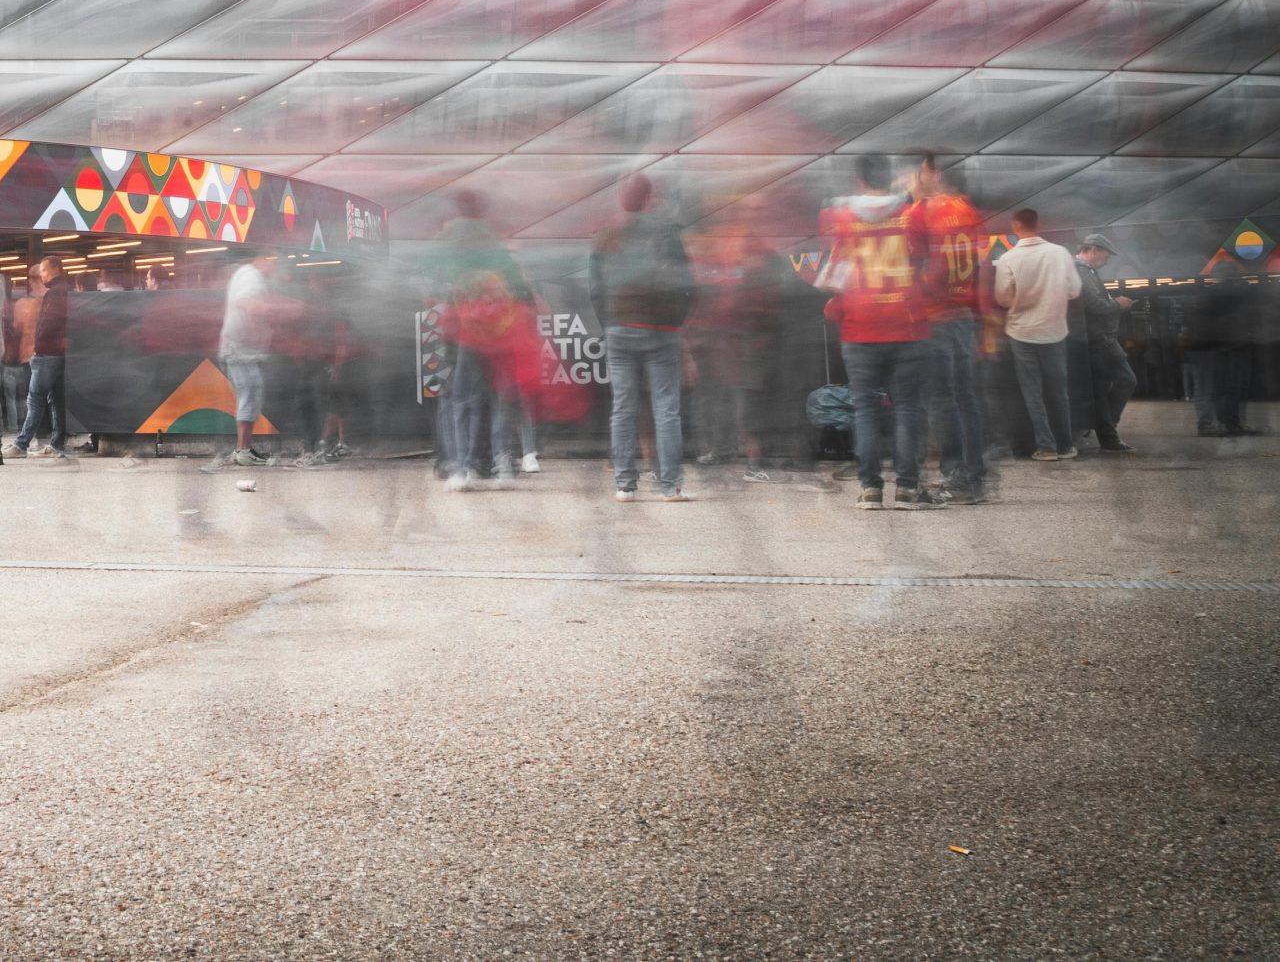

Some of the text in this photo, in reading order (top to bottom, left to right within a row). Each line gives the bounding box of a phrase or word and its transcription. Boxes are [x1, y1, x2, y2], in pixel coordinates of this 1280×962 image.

[537, 314, 588, 336] EFA
[540, 338, 607, 360] ATIO
[540, 362, 611, 385] EAGU
